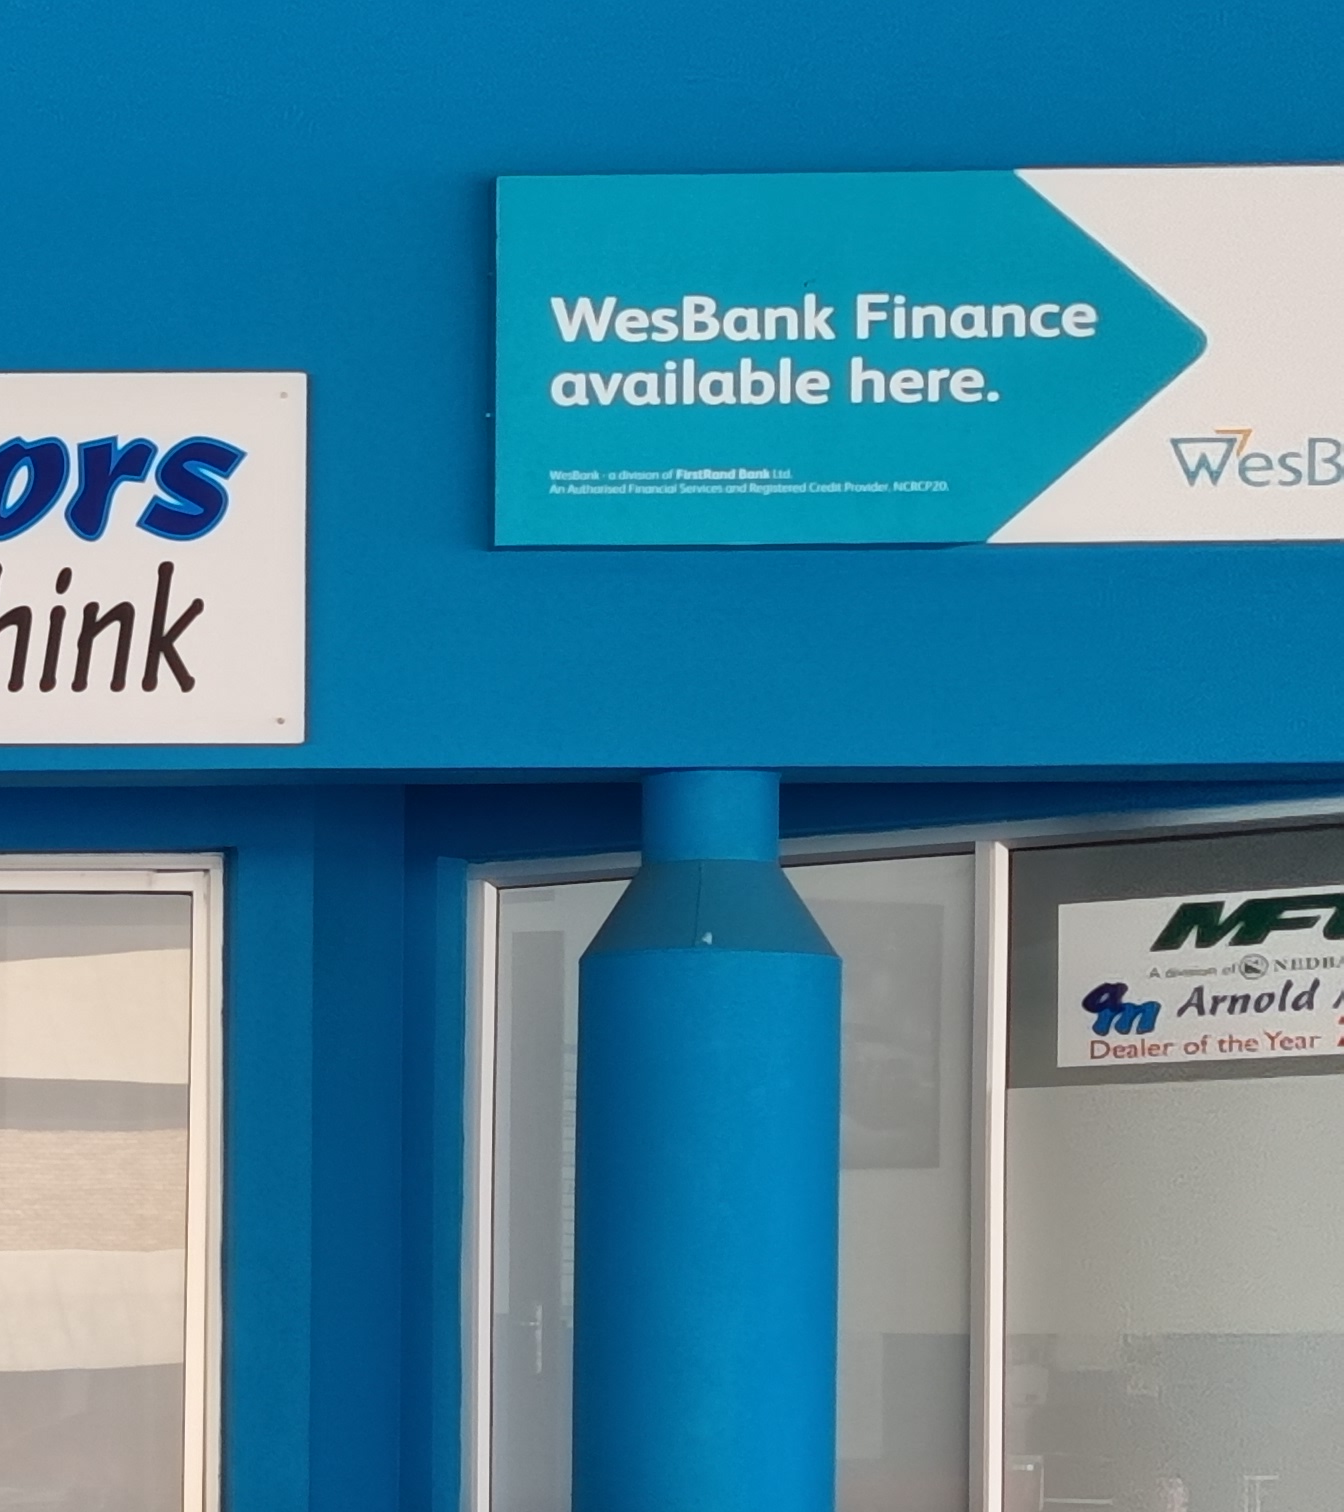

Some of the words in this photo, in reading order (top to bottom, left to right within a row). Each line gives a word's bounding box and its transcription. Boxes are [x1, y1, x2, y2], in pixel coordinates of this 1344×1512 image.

[551, 295, 835, 343] WesBank
[855, 292, 1097, 339] Finance
[551, 358, 830, 407] available
[849, 356, 1001, 404] here.
[549, 470, 600, 481] WesBank
[676, 469, 736, 480] FirstRand
[738, 469, 771, 480] Bank
[549, 484, 565, 494] An
[628, 483, 677, 494] Financial
[679, 483, 723, 494] Services
[725, 482, 749, 494] and
[749, 482, 807, 496] Registered
[808, 482, 842, 493] Credit
[1177, 978, 1320, 1017] Arnold
[1090, 1037, 1174, 1060] Dealer
[1183, 1034, 1212, 1056] of
[1218, 1034, 1259, 1053] the
[1264, 1030, 1322, 1051] Year
